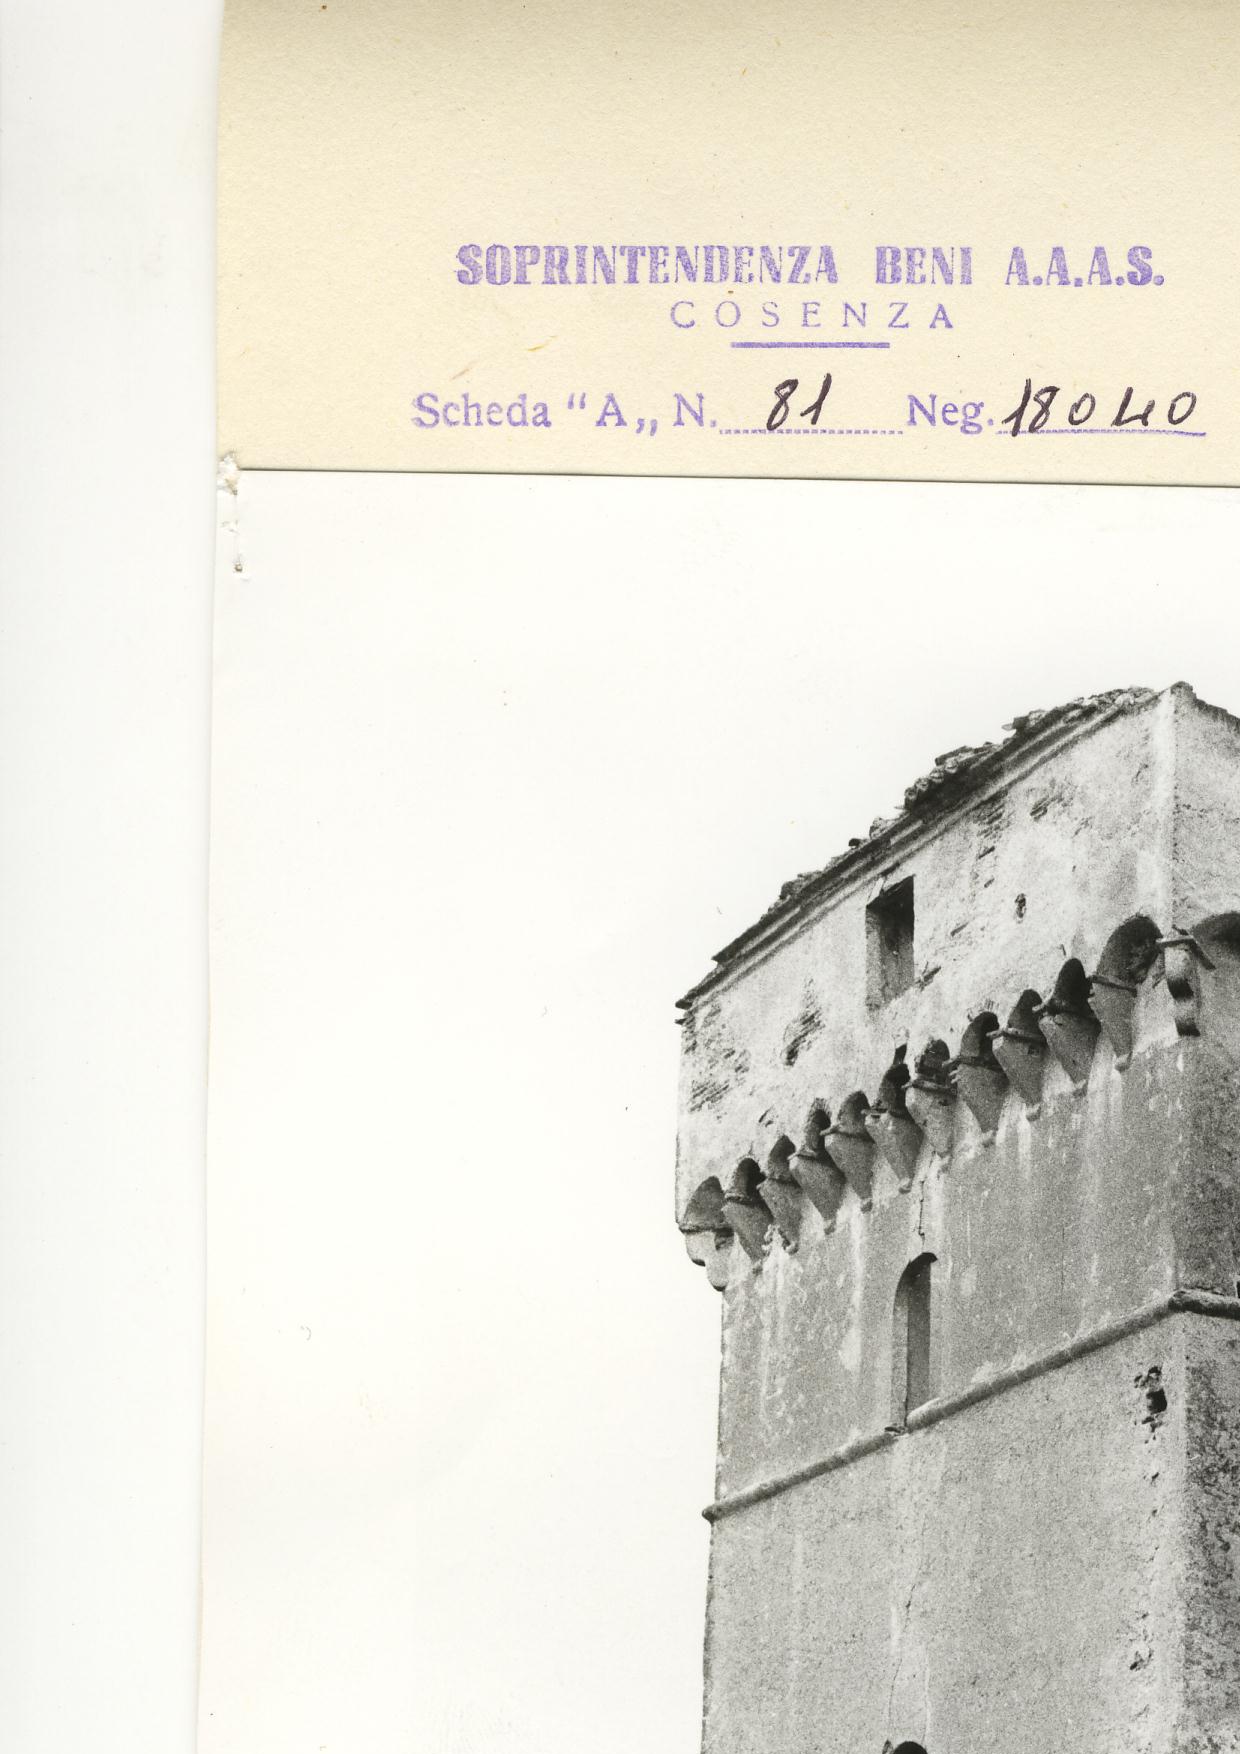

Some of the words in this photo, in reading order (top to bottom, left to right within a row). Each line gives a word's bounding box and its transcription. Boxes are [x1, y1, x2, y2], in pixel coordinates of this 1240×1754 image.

[455, 243, 839, 286] SOPRINTENDENZA
[875, 245, 973, 286] BENI
[1004, 245, 1165, 288] A.A.A.S.
[670, 300, 954, 329] COSENZA
[411, 392, 552, 429] Scheda
[672, 392, 717, 428] N.
[765, 372, 833, 432] 81
[906, 393, 994, 435] Neg.
[1001, 377, 1198, 437] 18040
